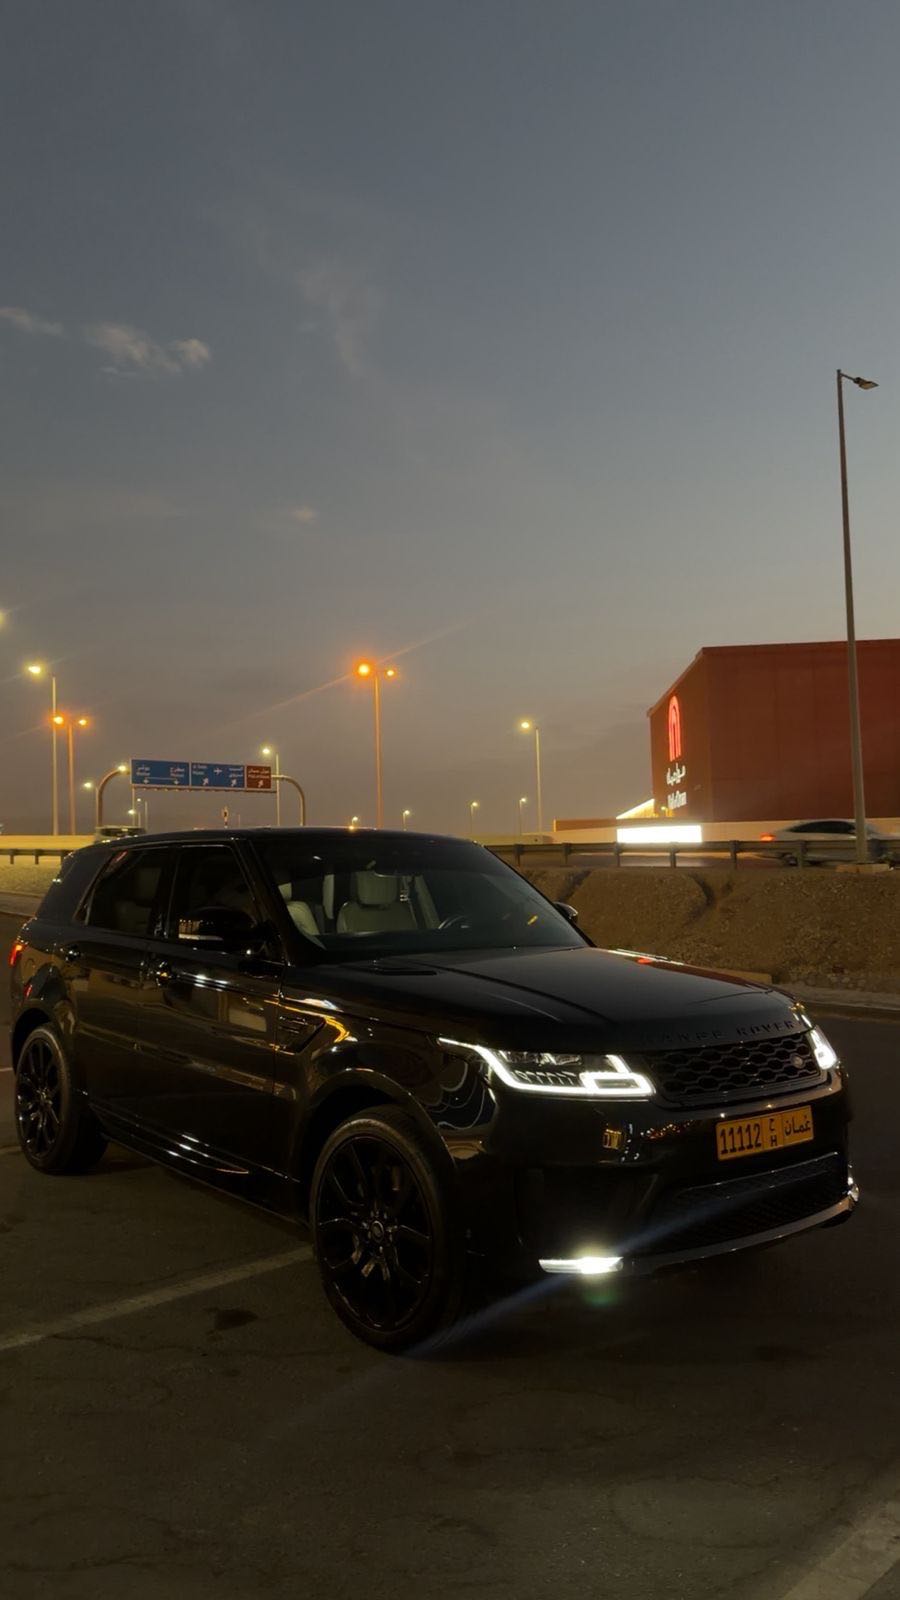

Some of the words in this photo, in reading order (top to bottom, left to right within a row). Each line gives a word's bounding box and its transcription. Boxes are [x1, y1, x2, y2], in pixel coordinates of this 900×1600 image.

[639, 1029, 725, 1044] ANGE
[736, 1020, 794, 1036] ROVER
[720, 1123, 762, 1154] 11112
[770, 1135, 778, 1147] H
